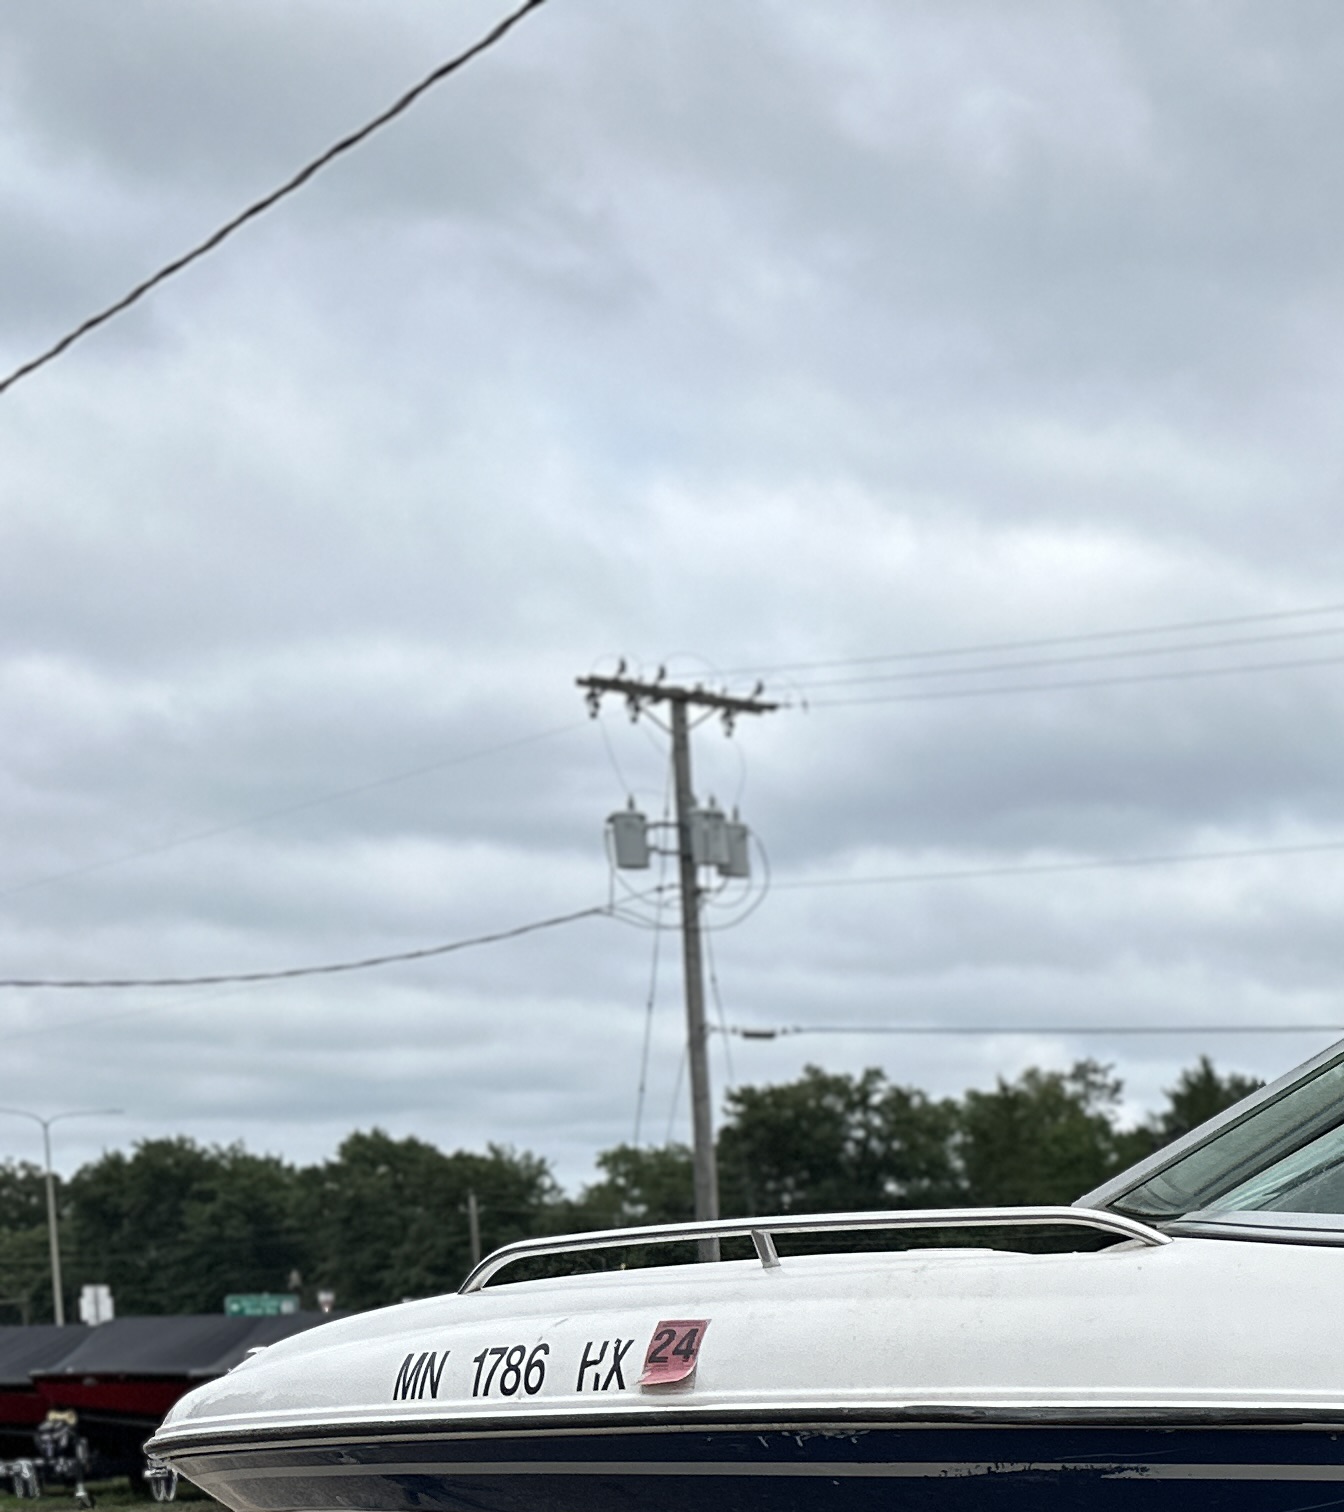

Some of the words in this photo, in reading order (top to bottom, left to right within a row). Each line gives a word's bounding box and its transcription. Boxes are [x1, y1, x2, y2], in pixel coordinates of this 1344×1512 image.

[393, 1350, 450, 1400] MN
[472, 1343, 550, 1398] 1786
[576, 1338, 636, 1393] HX
[647, 1327, 700, 1363] 24
